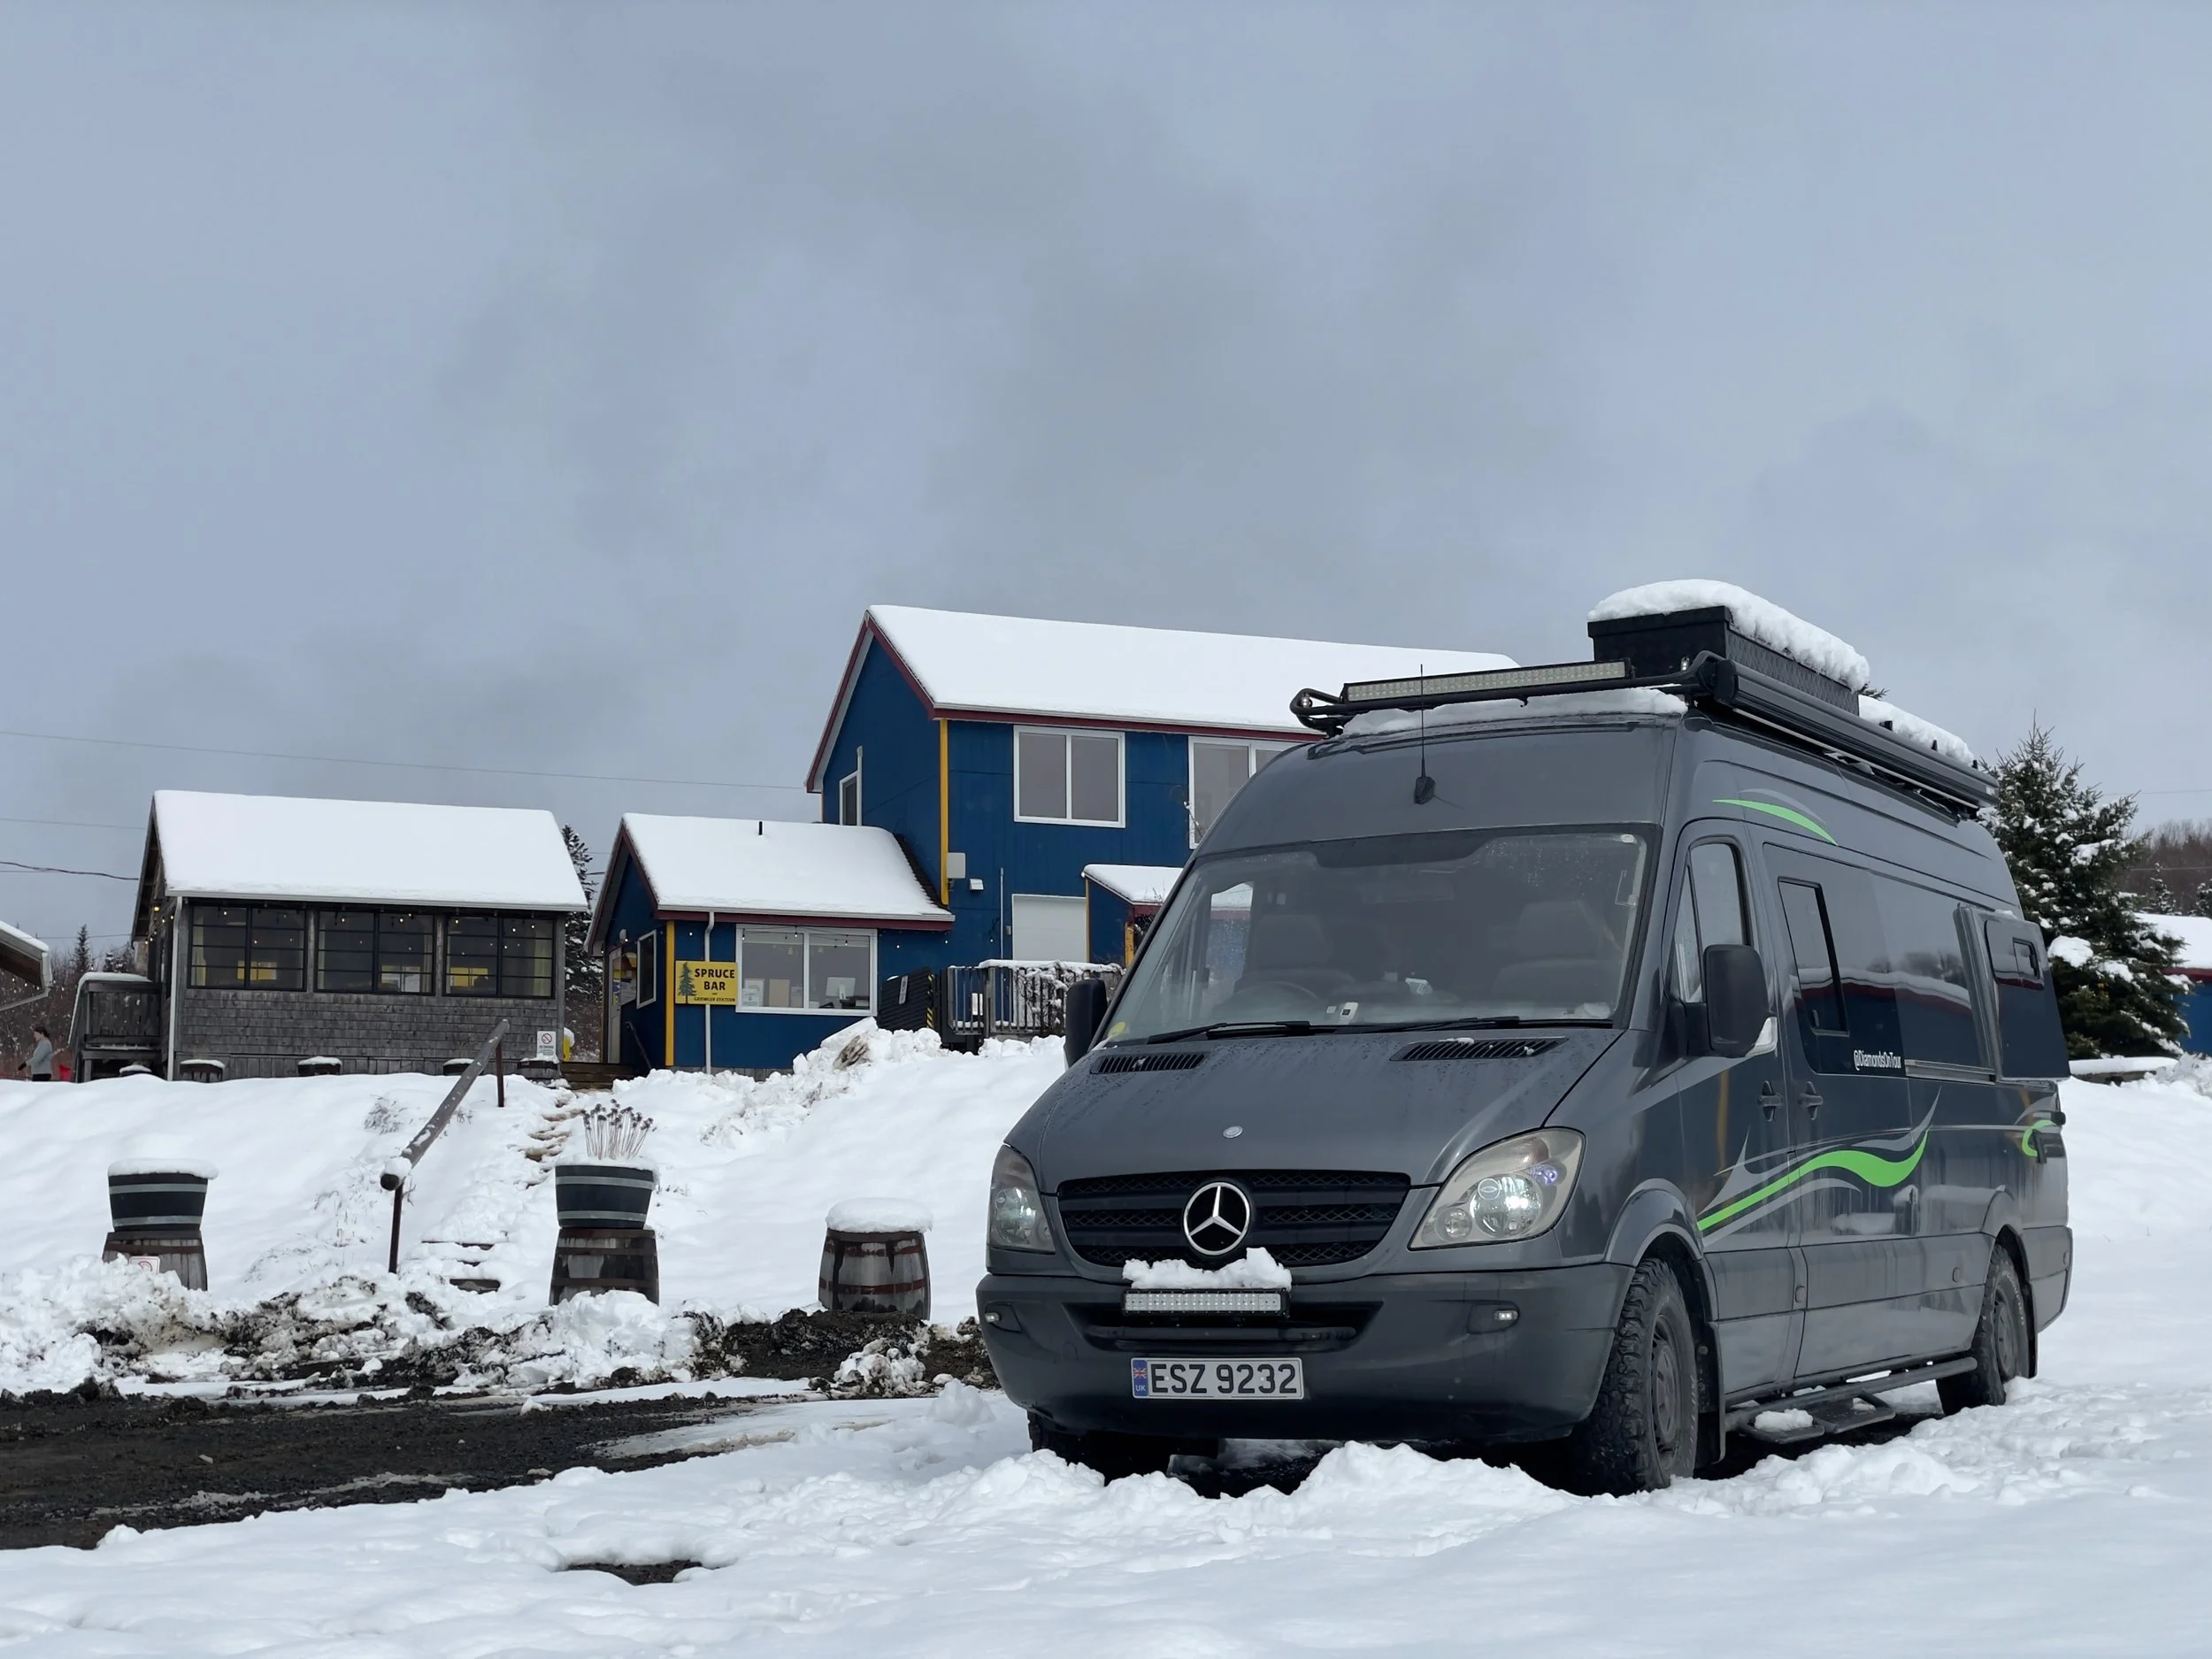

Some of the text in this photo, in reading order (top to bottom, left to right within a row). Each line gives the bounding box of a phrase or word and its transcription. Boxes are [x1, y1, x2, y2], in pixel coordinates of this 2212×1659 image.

[695, 968, 735, 979] SPRUCE
[703, 981, 726, 991] BAR
[1854, 1049, 1901, 1071] @DiamondsOnTour
[1150, 1363, 1297, 1394] ESZ 9232
